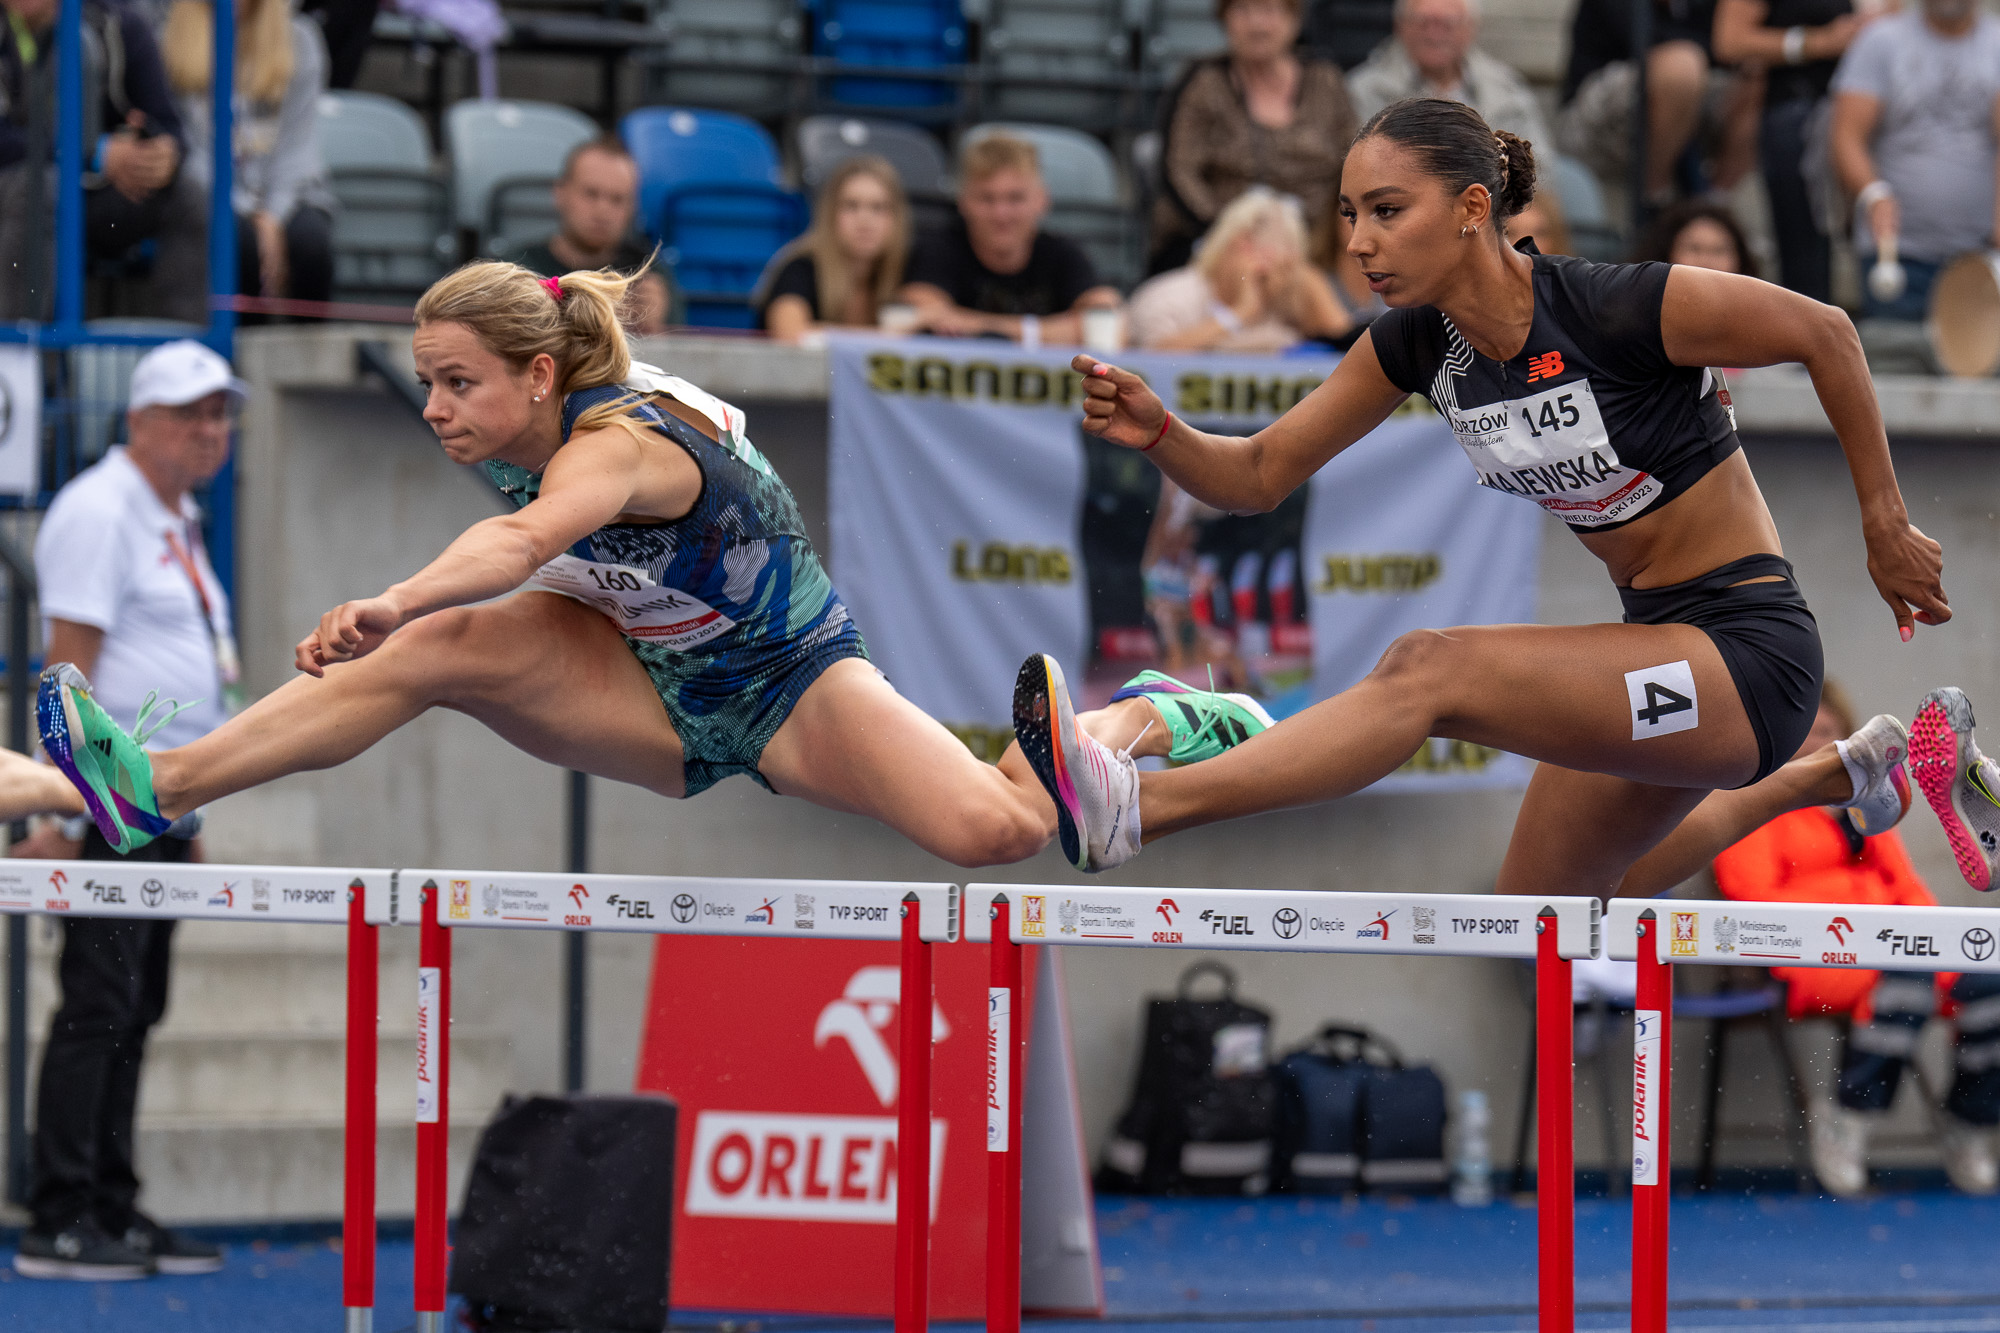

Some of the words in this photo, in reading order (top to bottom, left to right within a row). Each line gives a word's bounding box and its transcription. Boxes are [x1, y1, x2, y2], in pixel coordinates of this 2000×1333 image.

[1454, 412, 1508, 434] ORZÓW
[1521, 393, 1580, 437] 145
[1600, 488, 1630, 506] Polski
[1626, 485, 1653, 505] 2023
[949, 543, 1070, 584] LONG
[588, 567, 641, 591] 160
[1314, 554, 1441, 594] JUMP
[674, 620, 700, 634] Polski
[697, 622, 723, 638] 2023
[1637, 682, 1692, 725] 4
[93, 885, 126, 903] FUEL
[282, 889, 302, 902] TVP
[304, 890, 336, 904] SPORT
[617, 900, 655, 919] FUEL
[703, 902, 735, 919] Okęcie
[829, 905, 851, 920] TVP
[852, 906, 889, 922] SPORT
[1080, 904, 1122, 915] Ministerstwo
[564, 915, 592, 926] ORLEN
[1080, 916, 1101, 928] Sportu
[1106, 917, 1136, 929] Turystyki
[1212, 915, 1254, 935] FUEL
[1309, 916, 1345, 935] Okęcie
[1452, 918, 1477, 934] TVP
[1479, 919, 1520, 935] SPORT
[1739, 920, 1787, 932] Ministerstwo
[1151, 931, 1183, 944] ORLEN
[1356, 928, 1382, 939] polanik
[1739, 934, 1763, 946] Sportu
[1769, 935, 1802, 948] Turystyki
[1876, 929, 1894, 942] 4F
[1892, 935, 1941, 956] FUEL
[1671, 941, 1698, 954] PZLA
[1821, 952, 1857, 965] ORLEN
[417, 1004, 431, 1083] polanik
[987, 1026, 1001, 1110] polanik
[1633, 1051, 1650, 1141] polanik
